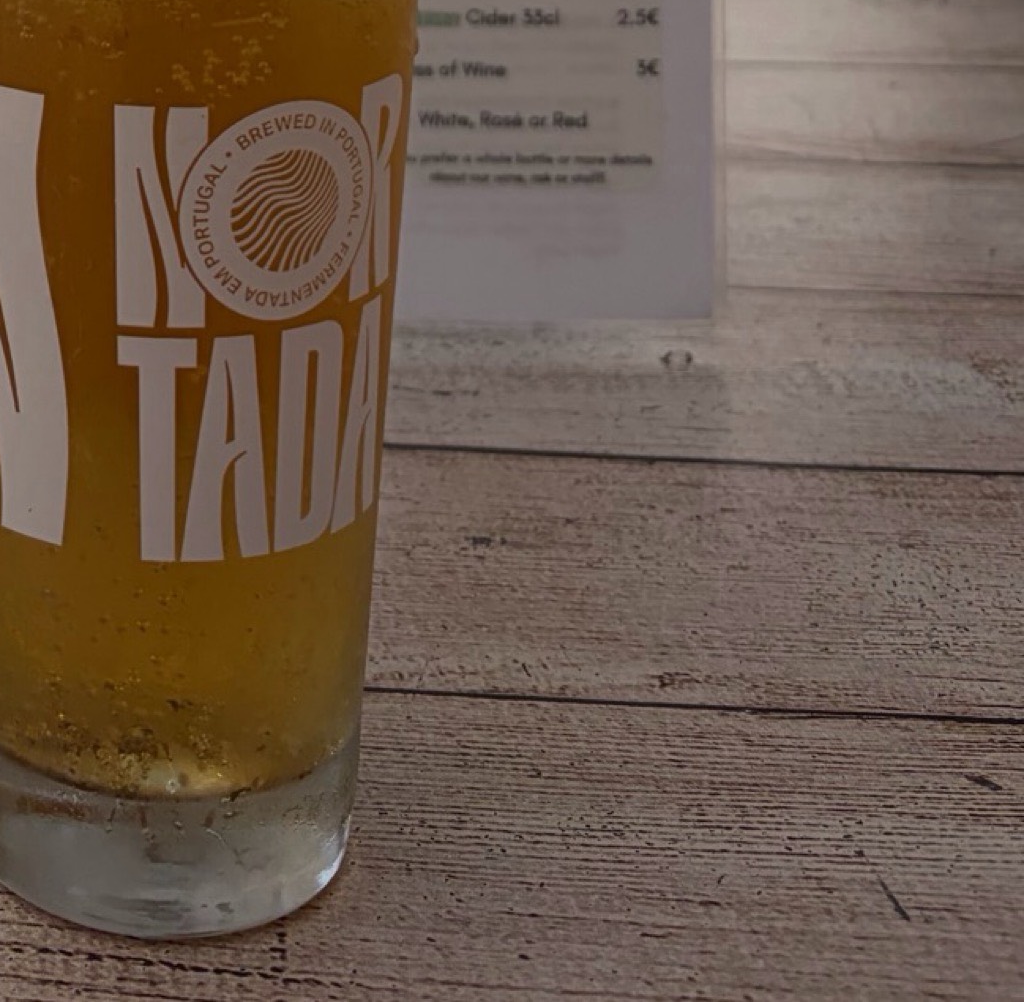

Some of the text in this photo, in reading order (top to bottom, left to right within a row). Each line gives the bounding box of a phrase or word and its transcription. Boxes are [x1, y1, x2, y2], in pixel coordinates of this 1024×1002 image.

[466, 9, 516, 26] Cider
[617, 8, 659, 24] 2.5€
[439, 60, 457, 77] of
[462, 61, 507, 77] Wine
[418, 111, 474, 128] White,
[529, 116, 547, 127] or
[553, 111, 588, 127] Red
[235, 113, 365, 228] BREWED IN PORTUGAL
[192, 163, 350, 307] FERMENTADA EM PORTUGAL
[117, 299, 382, 562] TADA
